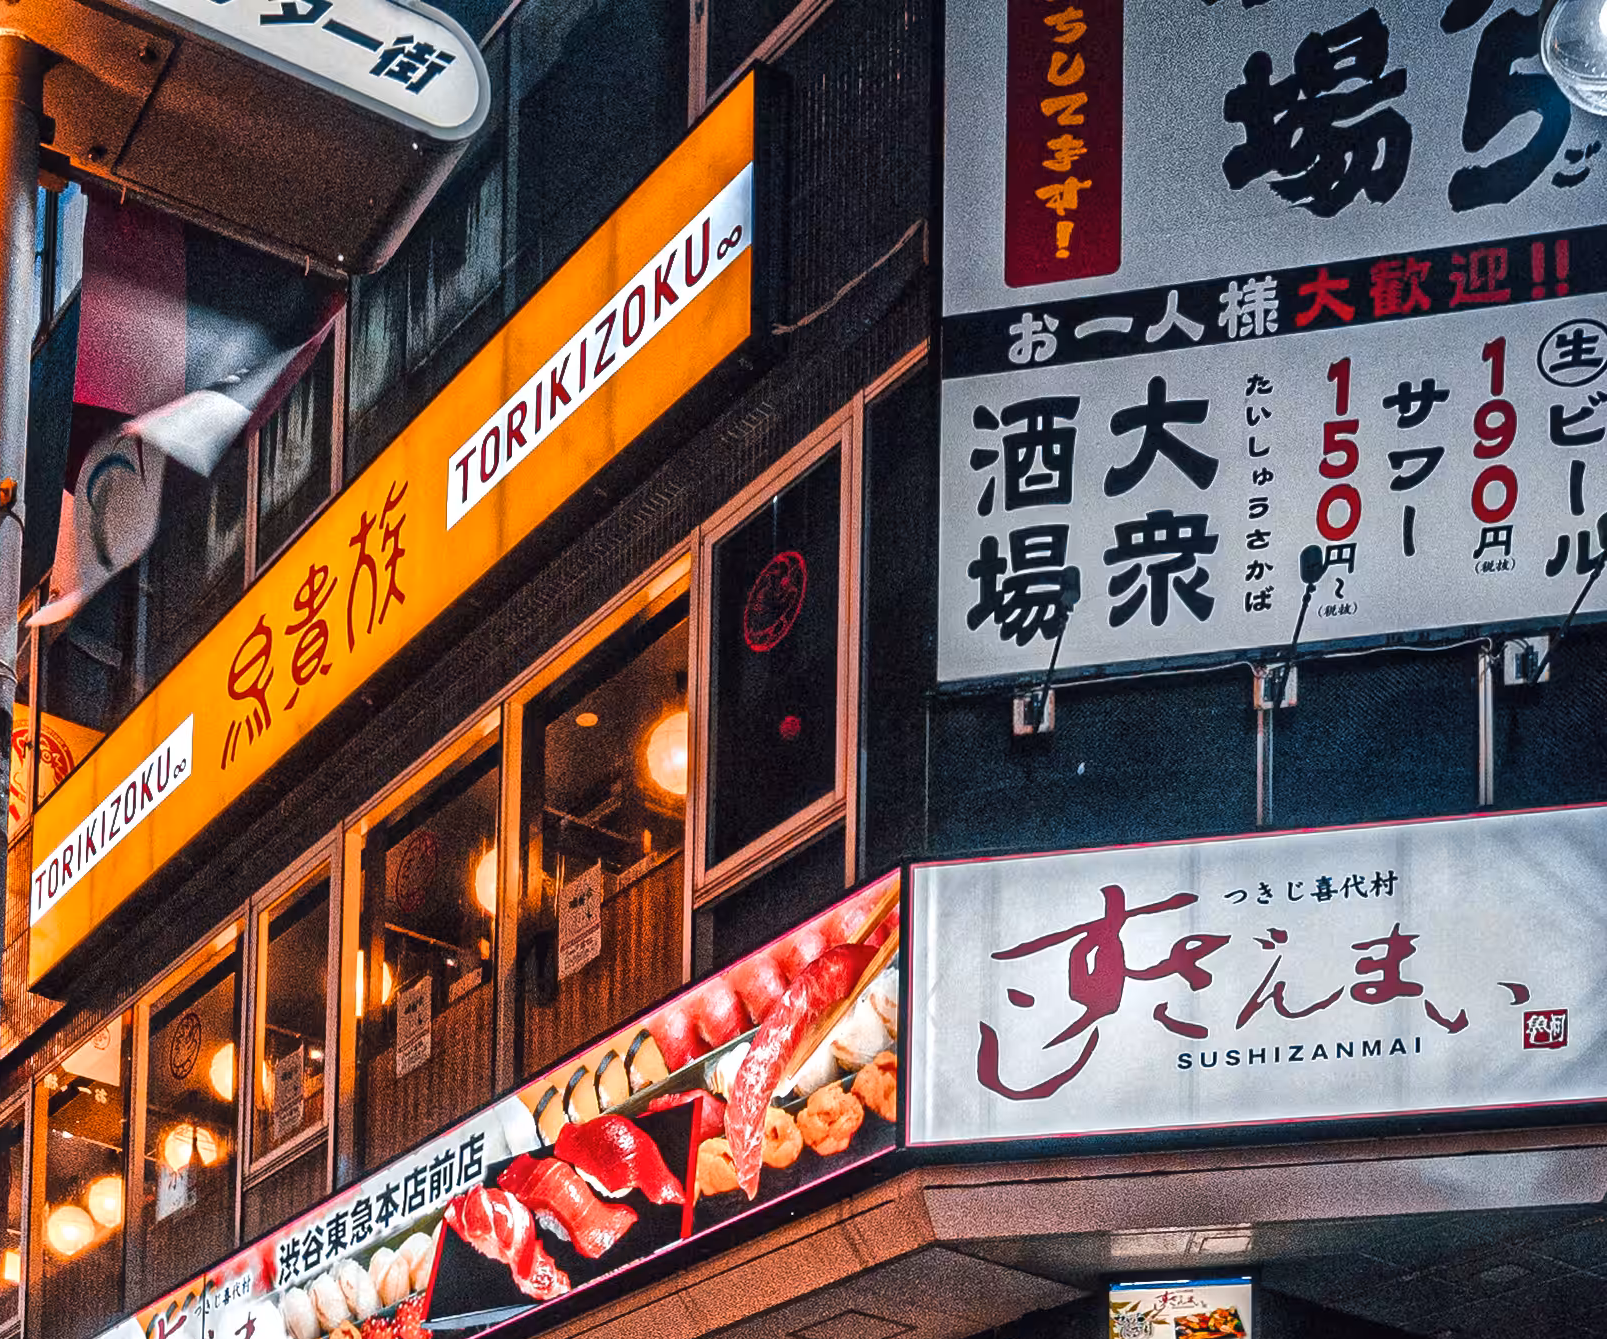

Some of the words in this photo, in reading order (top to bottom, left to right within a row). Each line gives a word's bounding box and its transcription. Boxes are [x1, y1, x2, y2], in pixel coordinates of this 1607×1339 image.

[455, 218, 713, 506] TORIKIZOKU
[1471, 336, 1518, 559] 190円
[967, 396, 1081, 647] 酒場
[1103, 376, 1220, 627] 大衆
[1382, 378, 1450, 557] サワー
[35, 746, 174, 910] TORIKIZOKU
[1224, 870, 1398, 904] つきじ喜代村
[1177, 1036, 1424, 1070] SUSHIZANMAI
[278, 1131, 486, 1285] 渋谷東急本店前店
